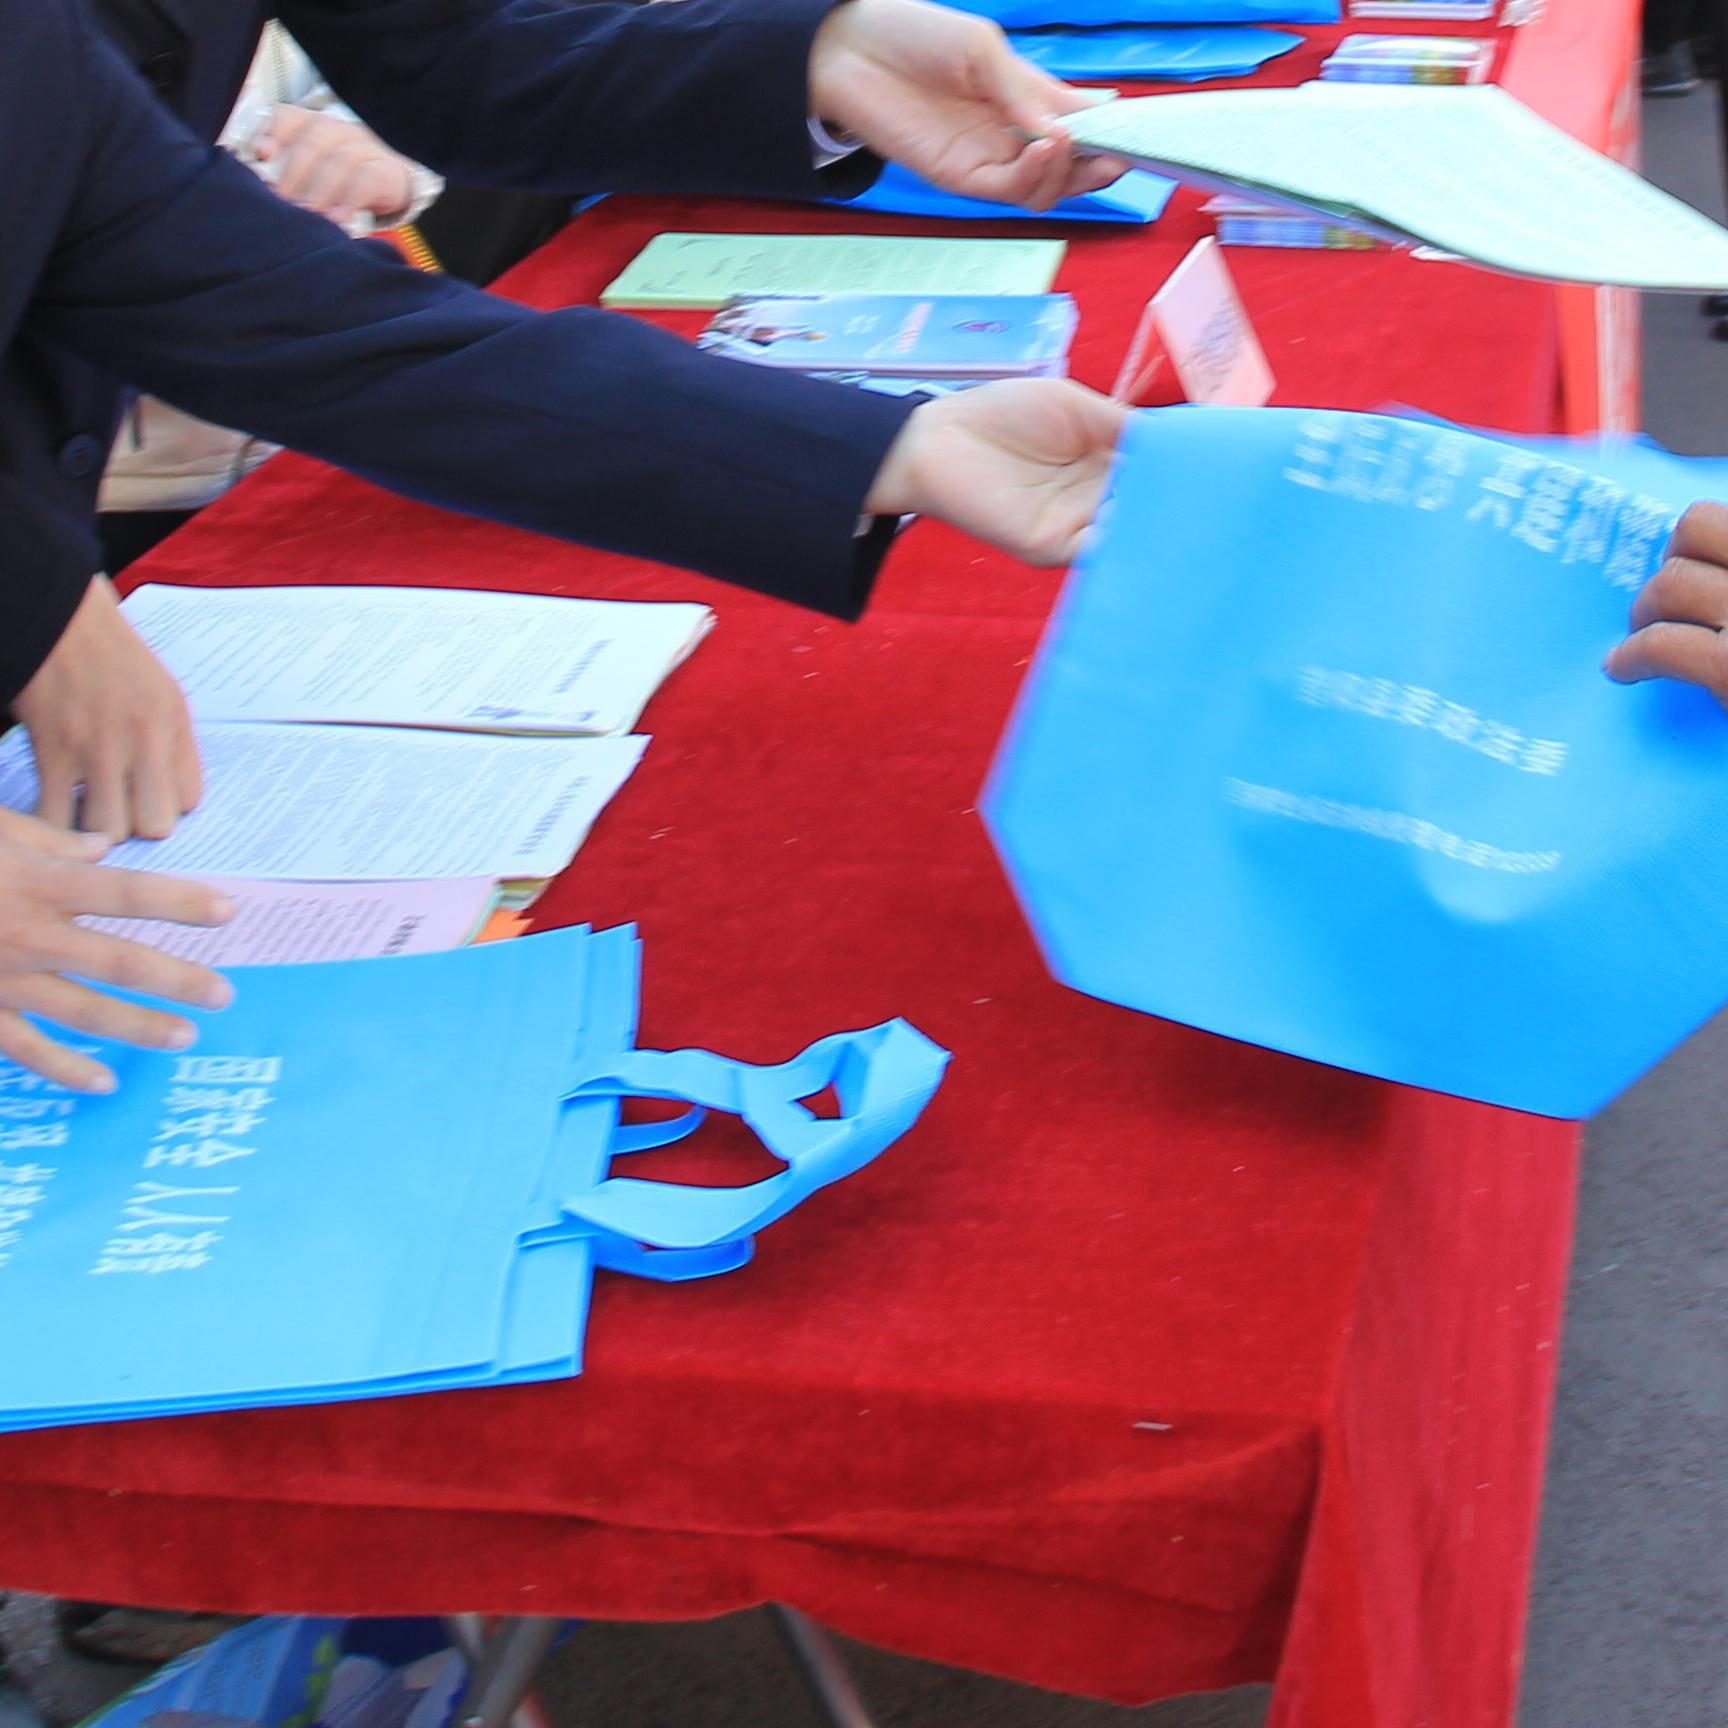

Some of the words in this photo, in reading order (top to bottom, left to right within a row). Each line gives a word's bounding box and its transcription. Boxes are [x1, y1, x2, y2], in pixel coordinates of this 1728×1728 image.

[141, 1054, 284, 1171] 国家安全
[88, 1179, 241, 1276] 人人有责
